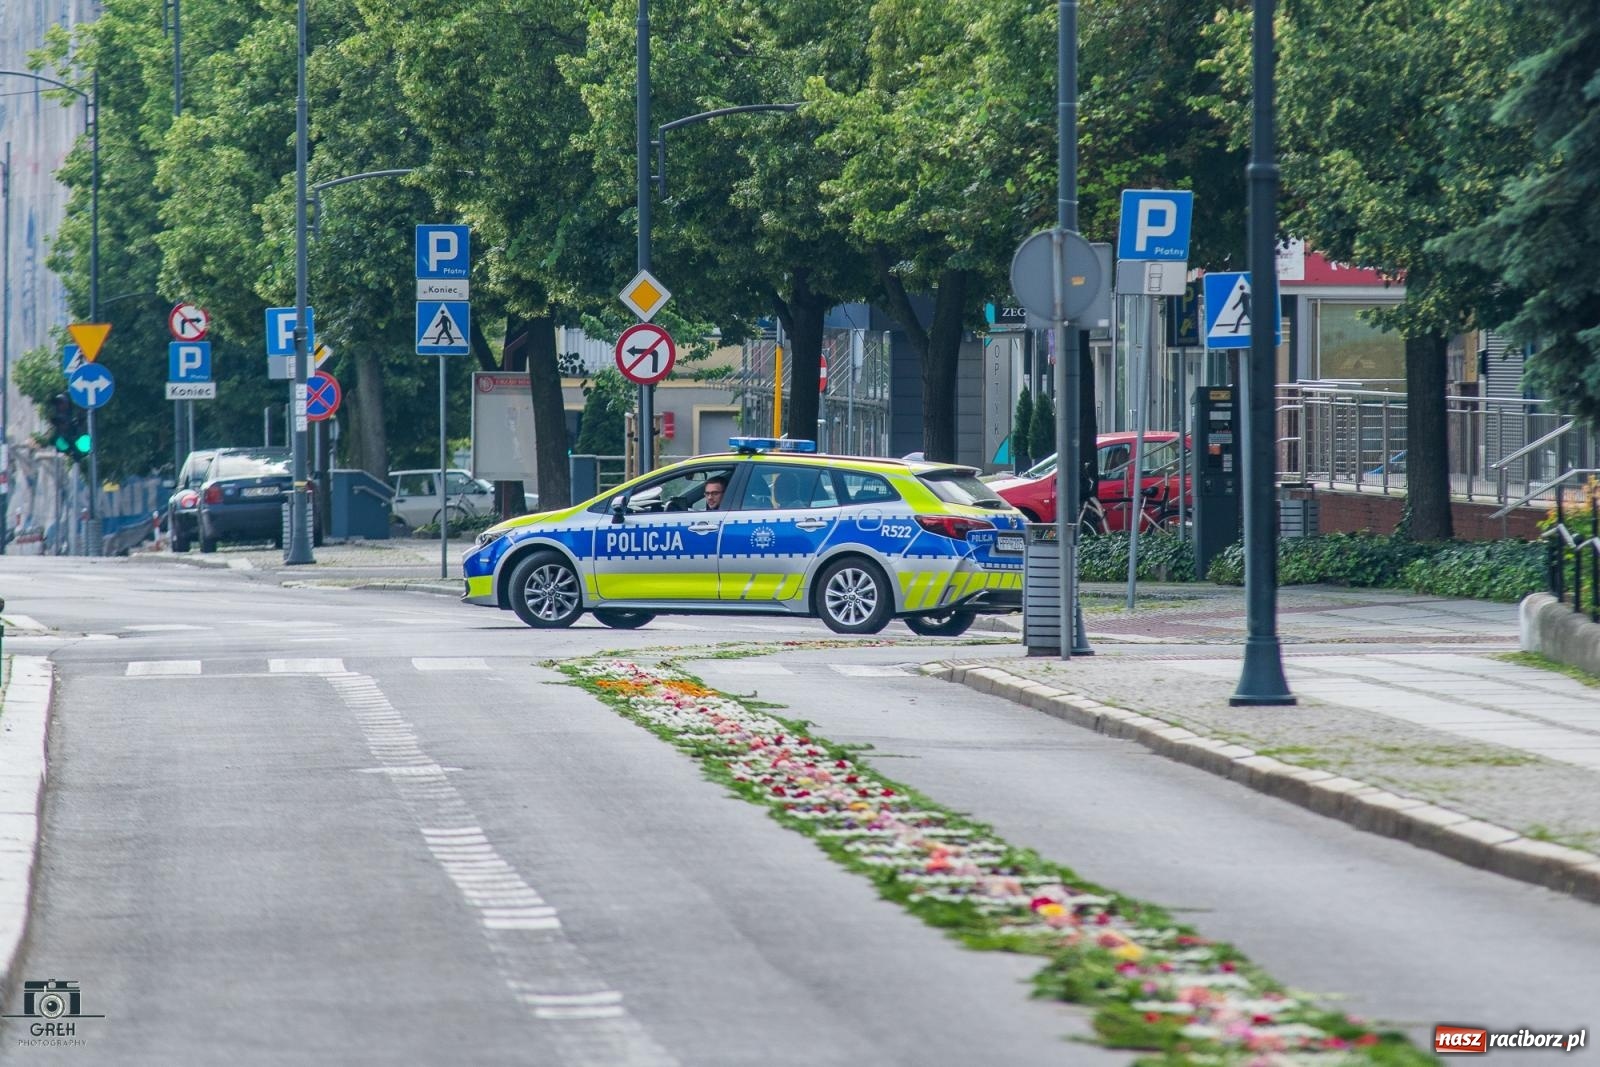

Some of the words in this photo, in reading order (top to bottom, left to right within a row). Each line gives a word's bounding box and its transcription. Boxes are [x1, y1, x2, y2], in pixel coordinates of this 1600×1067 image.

[1135, 198, 1177, 252] P
[428, 231, 458, 272] P
[428, 285, 458, 294] Koniec
[179, 346, 202, 378] P
[170, 386, 212, 397] Koniec
[881, 524, 912, 539] R522
[971, 533, 994, 543] POLICJA
[607, 530, 684, 552] POLICJA
